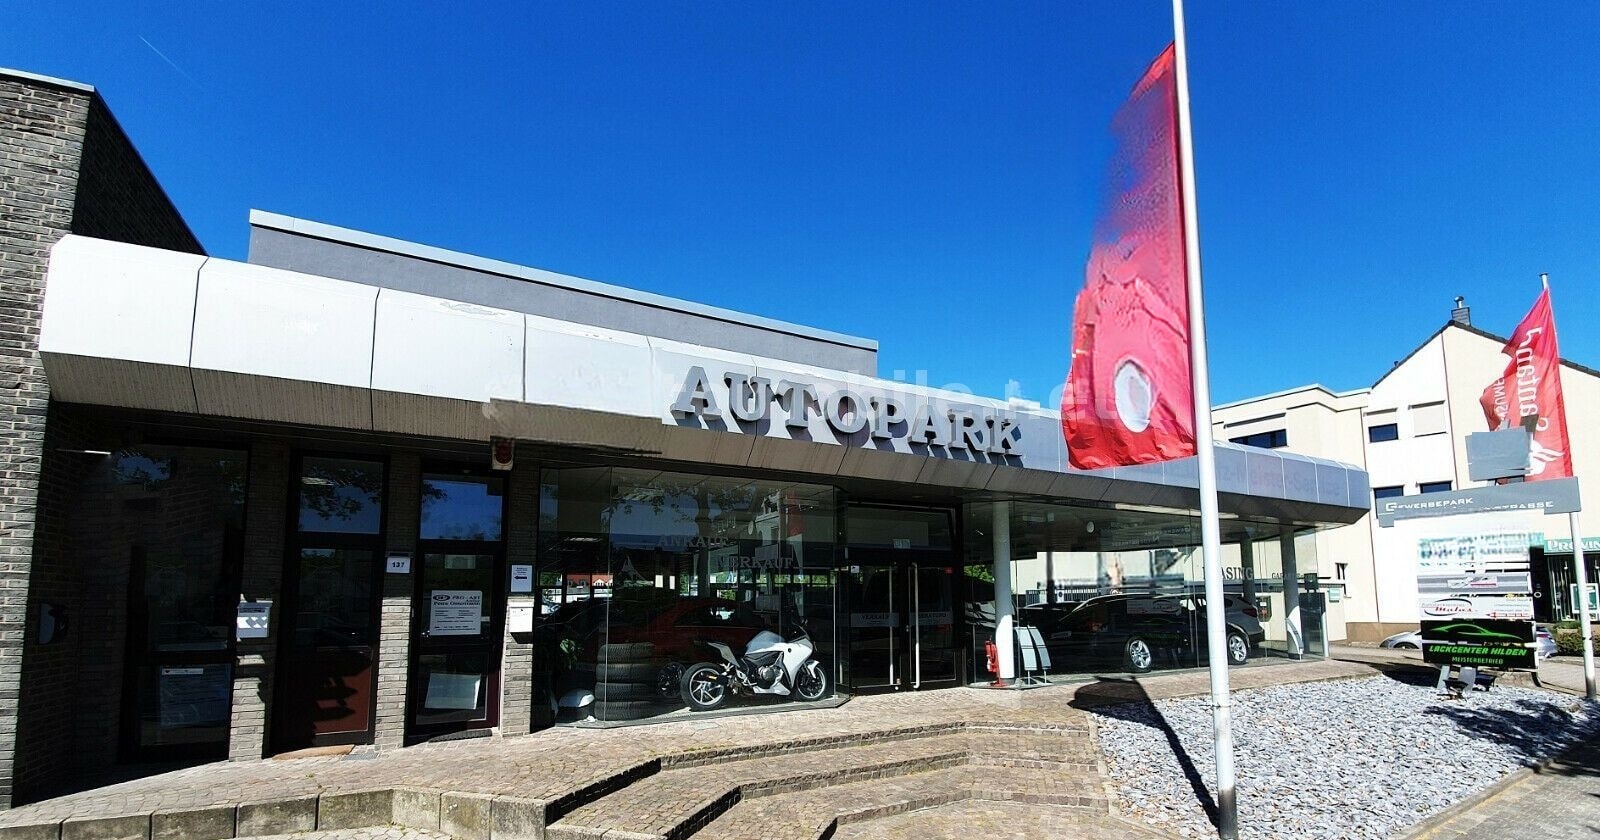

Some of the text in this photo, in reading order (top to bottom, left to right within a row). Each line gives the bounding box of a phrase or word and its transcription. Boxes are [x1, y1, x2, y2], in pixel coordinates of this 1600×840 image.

[669, 365, 1024, 456] AUTOPARK
[656, 534, 732, 549] ANKAUF
[392, 560, 405, 568] 137
[1429, 645, 1528, 656] LACKCENTER HILDEN
[1451, 656, 1504, 665] MEISTERBETRIEB
